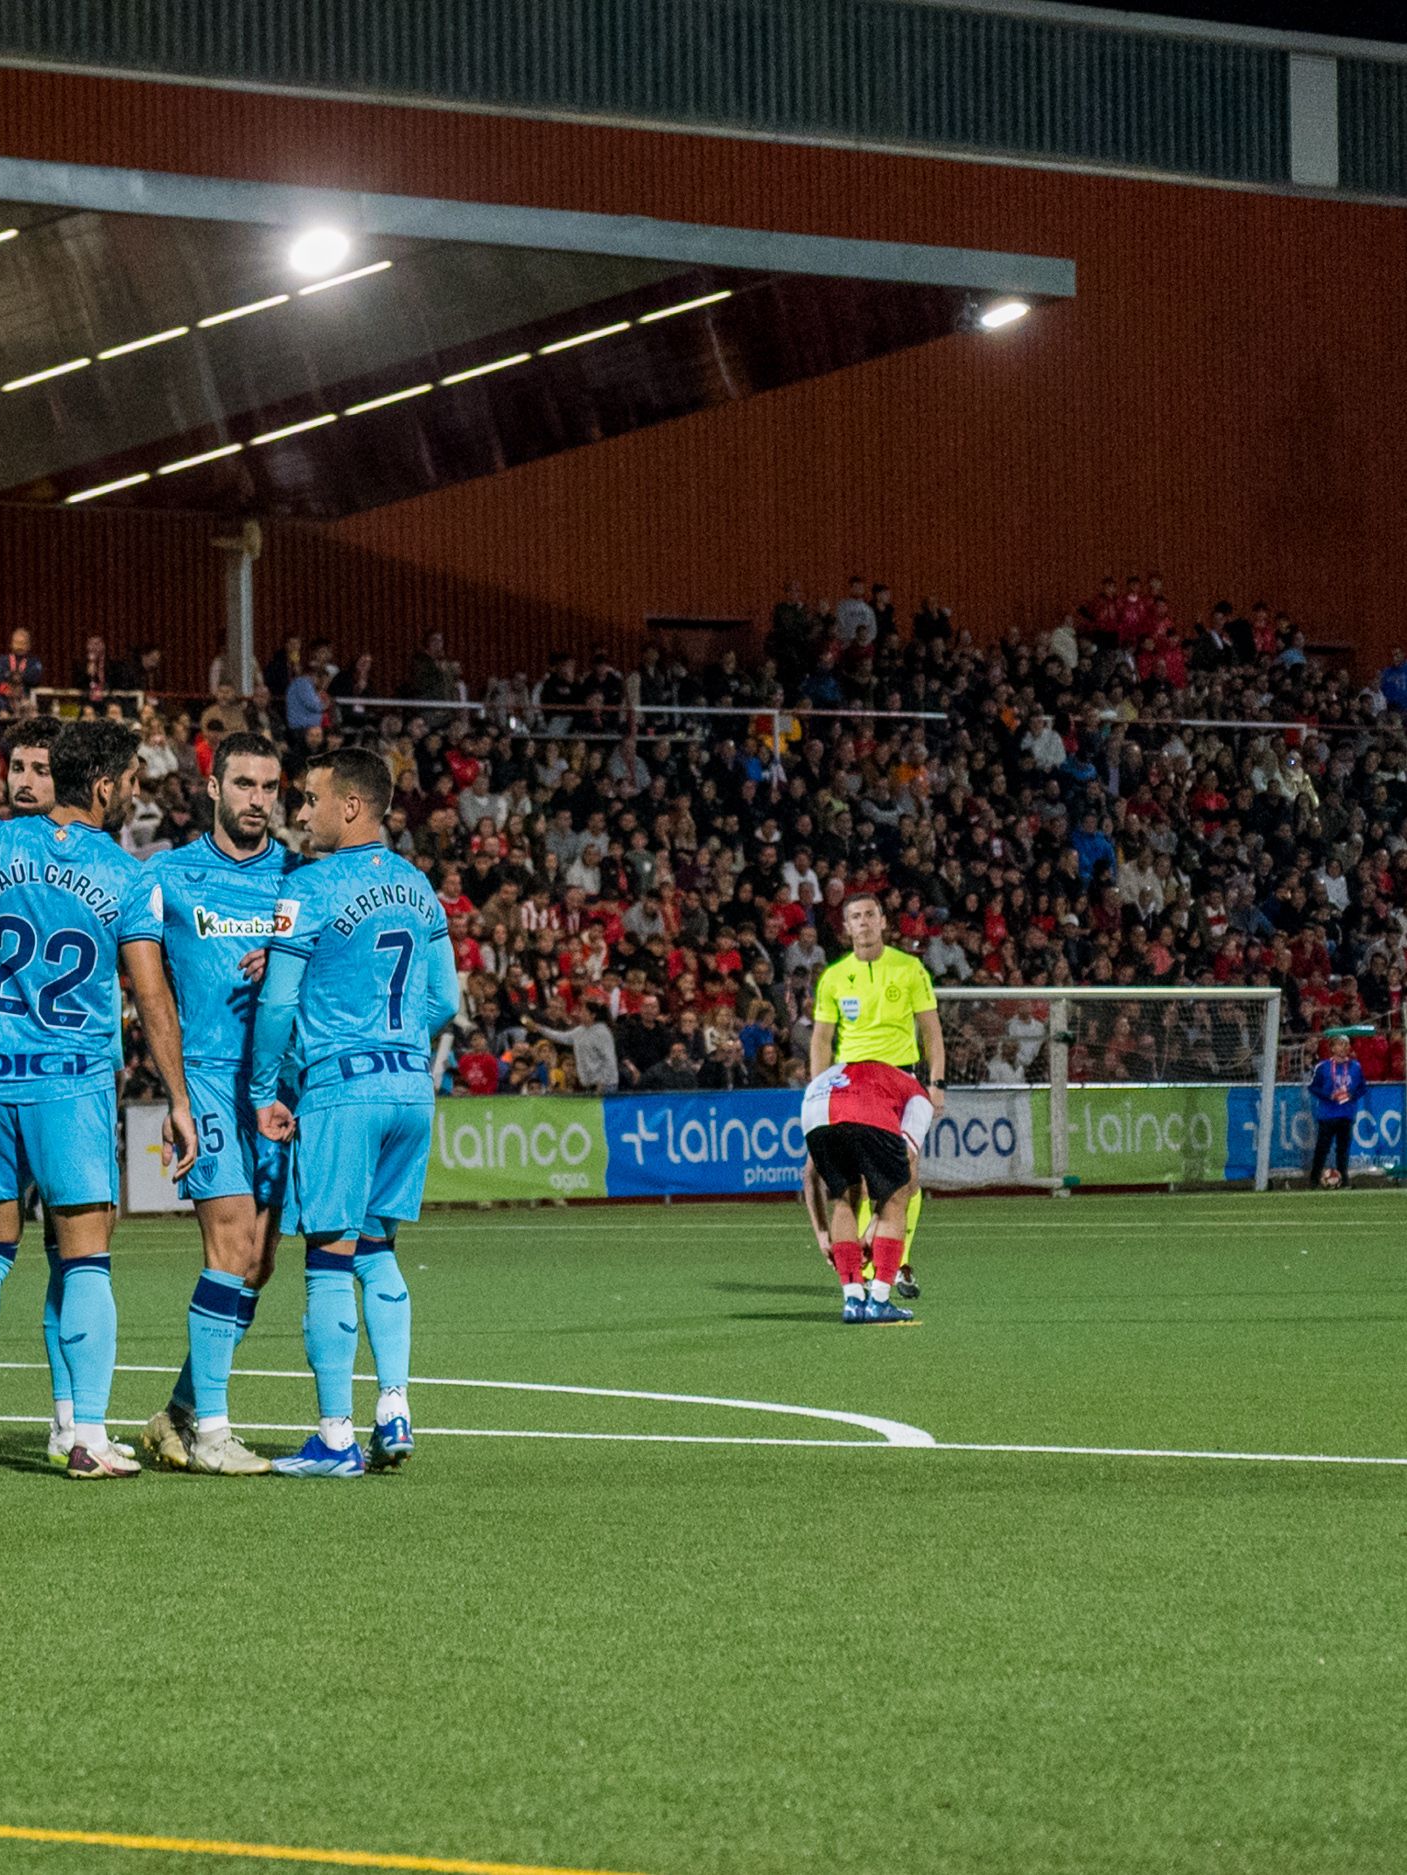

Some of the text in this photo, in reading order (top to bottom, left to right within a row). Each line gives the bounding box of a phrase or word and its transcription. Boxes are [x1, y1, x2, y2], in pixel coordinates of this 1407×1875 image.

[44, 864, 120, 927] GARCÍA
[332, 884, 435, 937] BERENGUER
[195, 907, 276, 937] Kutxaba
[374, 929, 414, 1032] 7
[338, 1050, 430, 1080] DIG
[438, 1111, 592, 1169] lainco
[924, 1116, 1017, 1158] inco
[1279, 1100, 1402, 1150] laco
